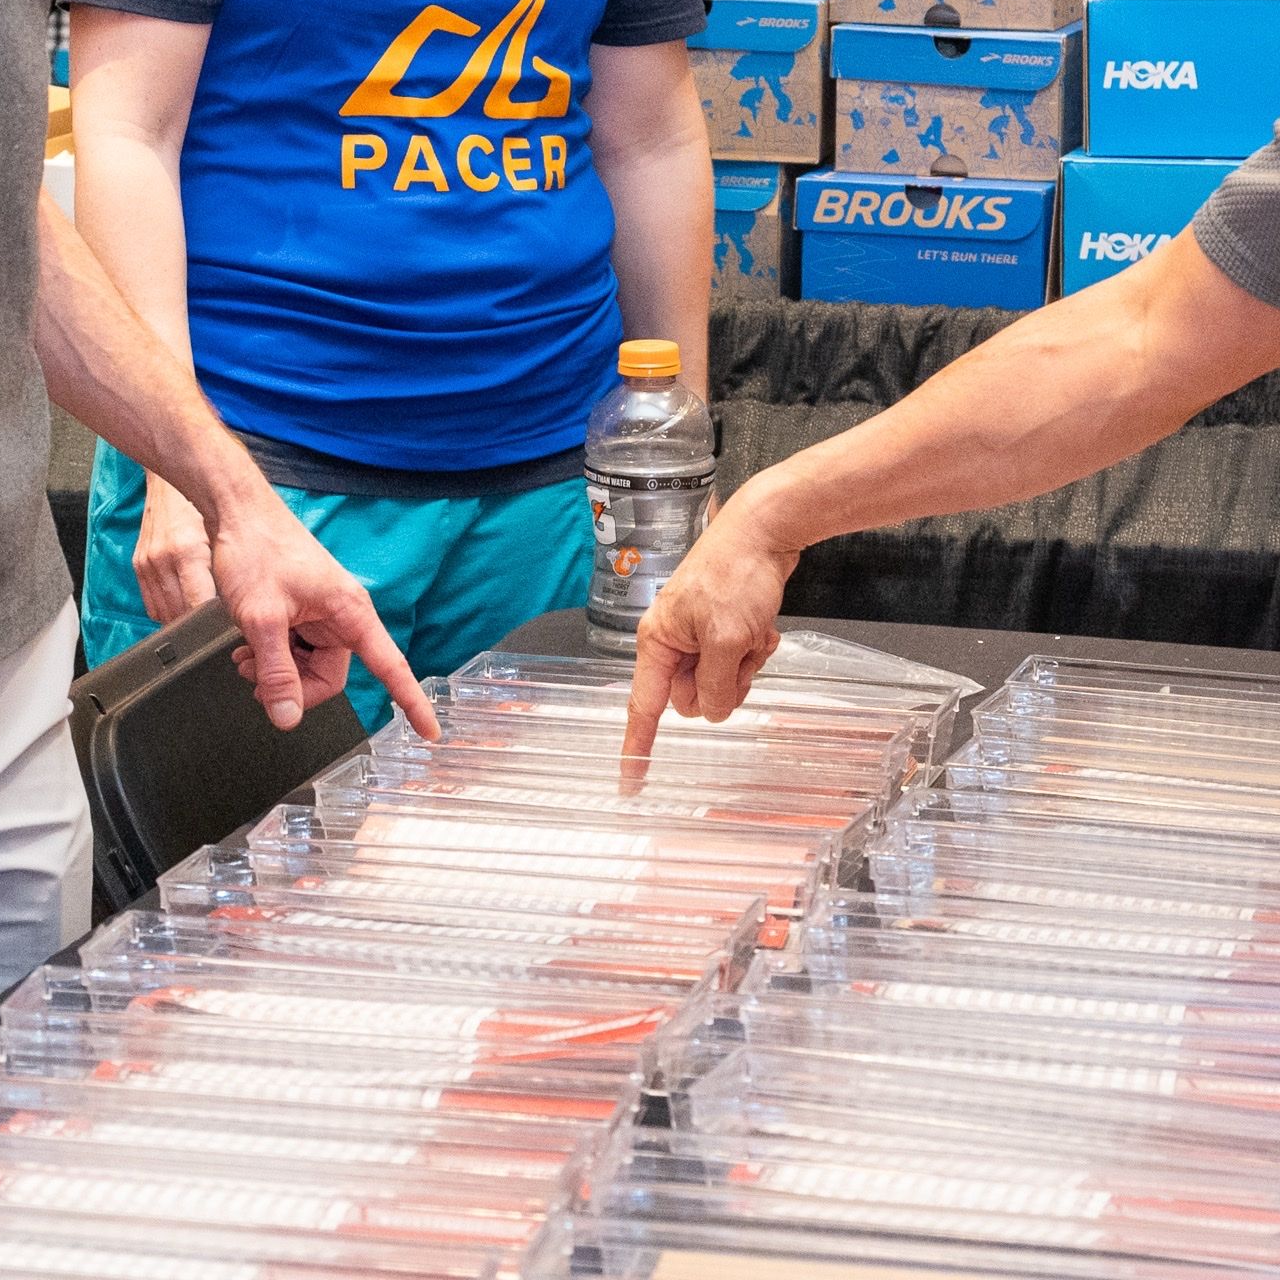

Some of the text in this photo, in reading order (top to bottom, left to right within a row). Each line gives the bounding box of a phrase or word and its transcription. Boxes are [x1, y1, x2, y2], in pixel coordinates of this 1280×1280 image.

[758, 17, 810, 29] BROOKS
[1002, 53, 1055, 67] BROOKS
[1103, 60, 1198, 89] HOKA
[341, 133, 568, 192] PACER
[812, 189, 1013, 231] BROOKS
[917, 249, 1019, 265] LET'S RUN THERE
[610, 477, 632, 489] WATER
